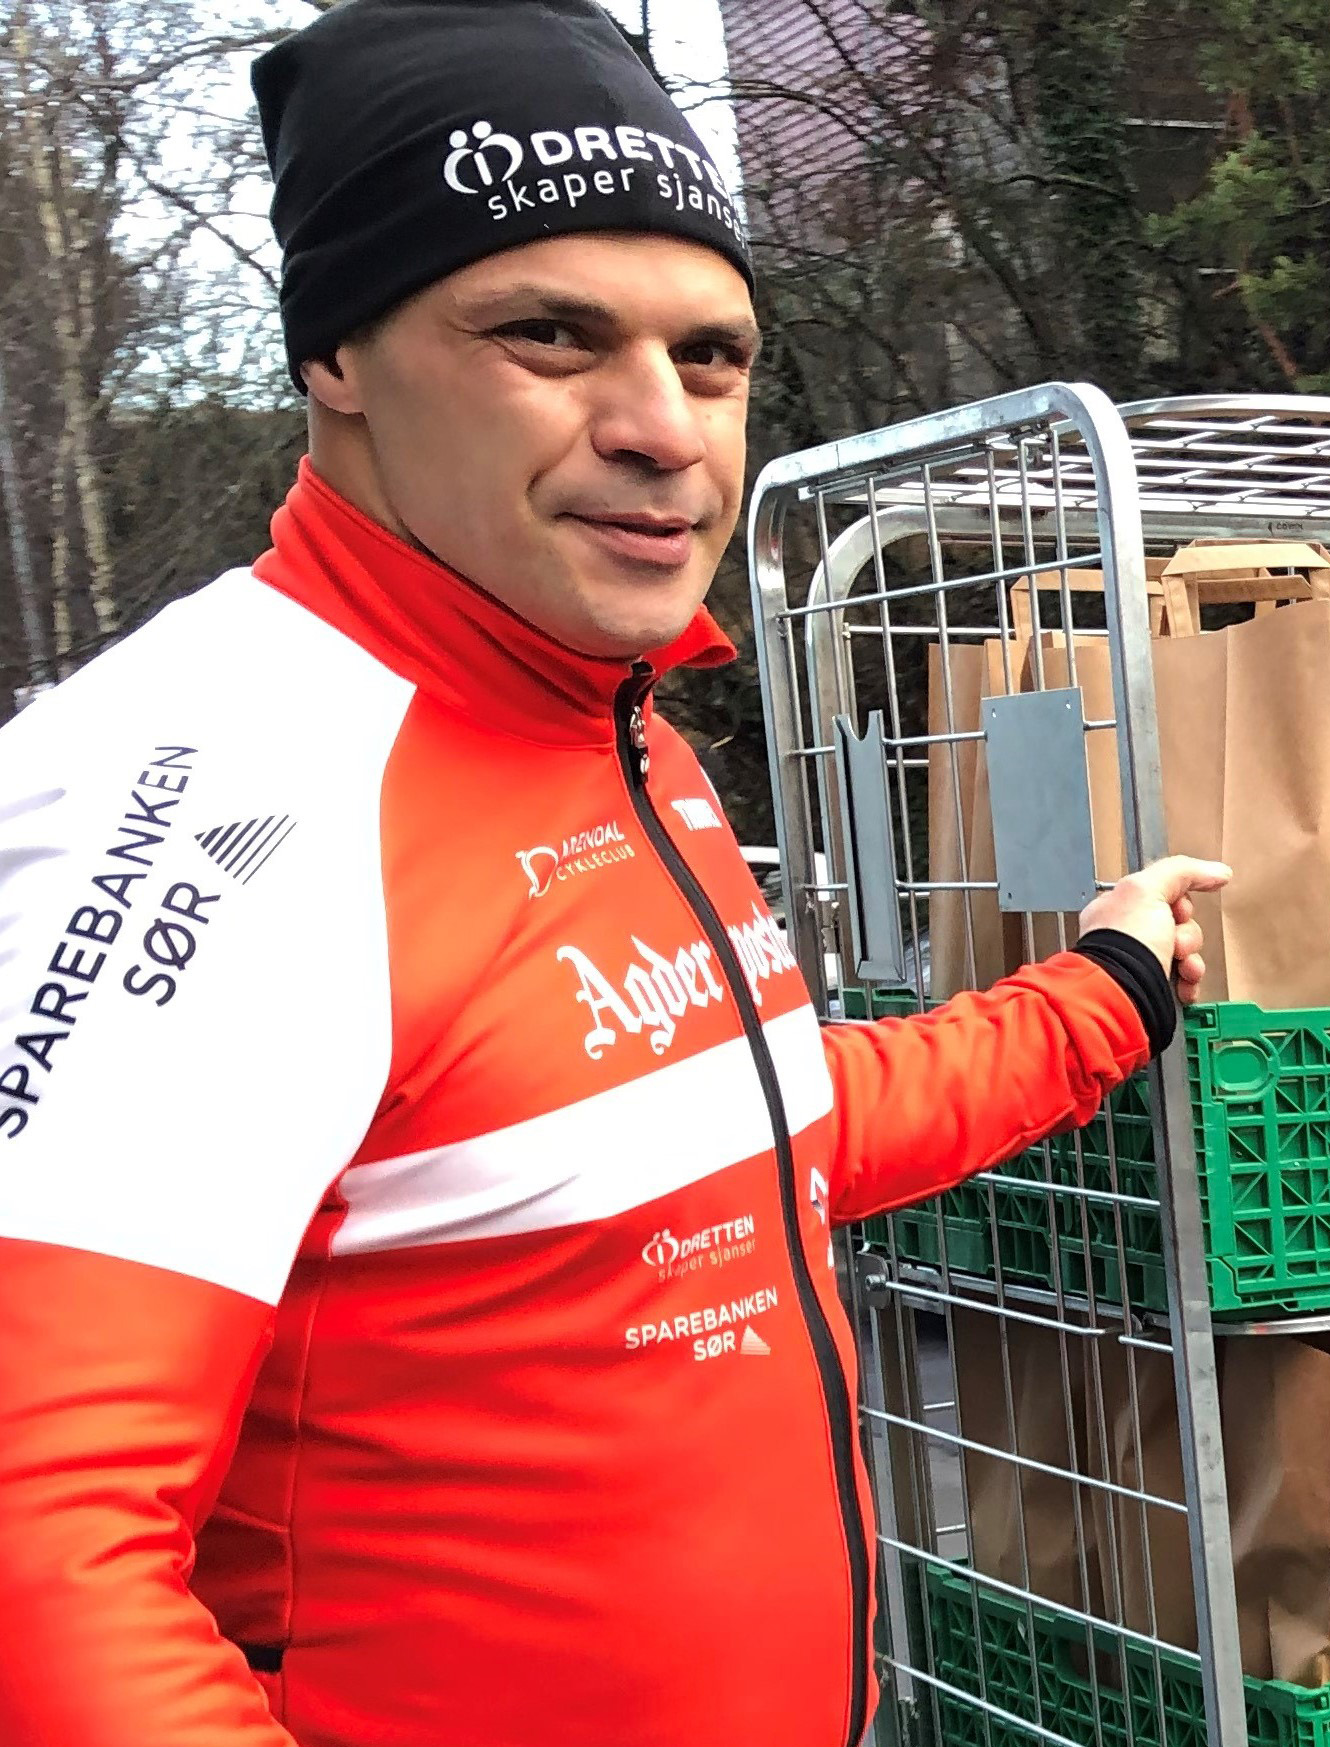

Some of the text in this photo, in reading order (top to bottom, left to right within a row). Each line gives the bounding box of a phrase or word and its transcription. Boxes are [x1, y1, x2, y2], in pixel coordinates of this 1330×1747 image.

[488, 167, 634, 221] skaper
[531, 125, 734, 207] DRETTE
[0, 746, 198, 1140] SPAREBANKEN
[122, 881, 221, 1007] SØR
[556, 934, 724, 1060] Agder
[680, 1214, 755, 1260] DRETTEN
[625, 1286, 778, 1349] SPAREBANKEN
[693, 1331, 736, 1362] SØR
